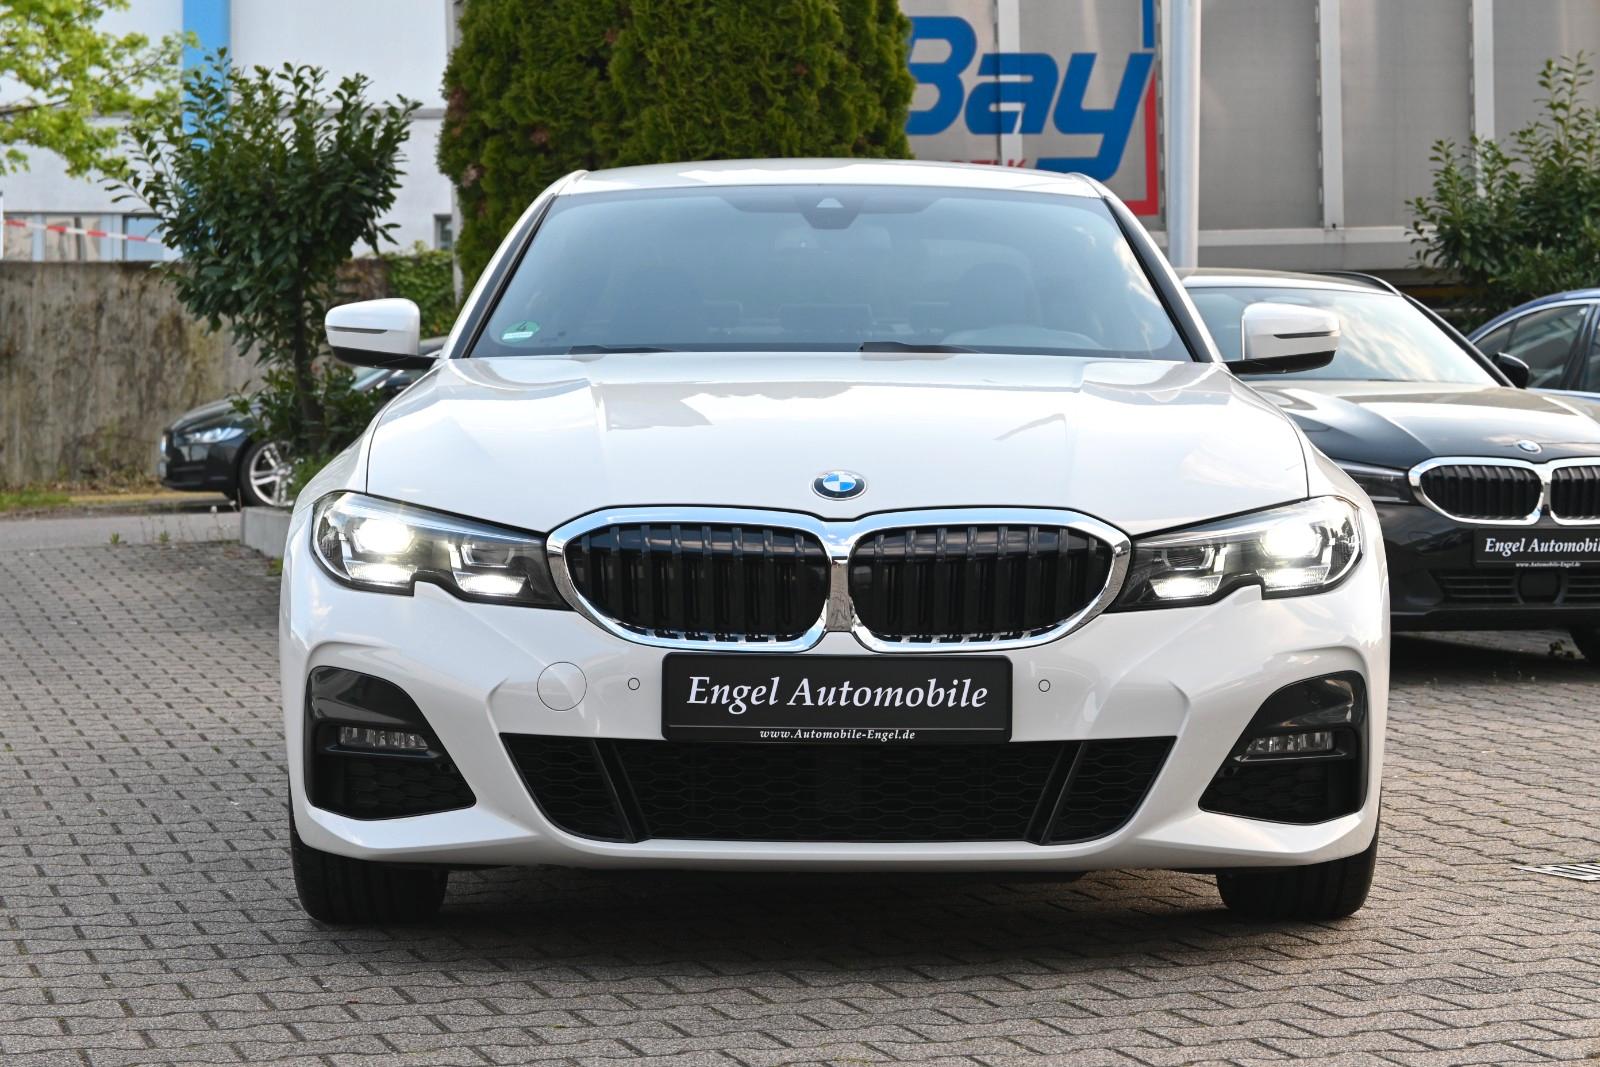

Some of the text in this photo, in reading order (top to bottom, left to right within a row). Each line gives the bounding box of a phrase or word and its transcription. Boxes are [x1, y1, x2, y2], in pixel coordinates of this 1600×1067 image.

[906, 15, 1155, 182] Bay
[1485, 537, 1525, 557] Engel
[686, 676, 988, 715] Engel Automobile
[759, 729, 916, 741] www.Automobile-Engel.de
